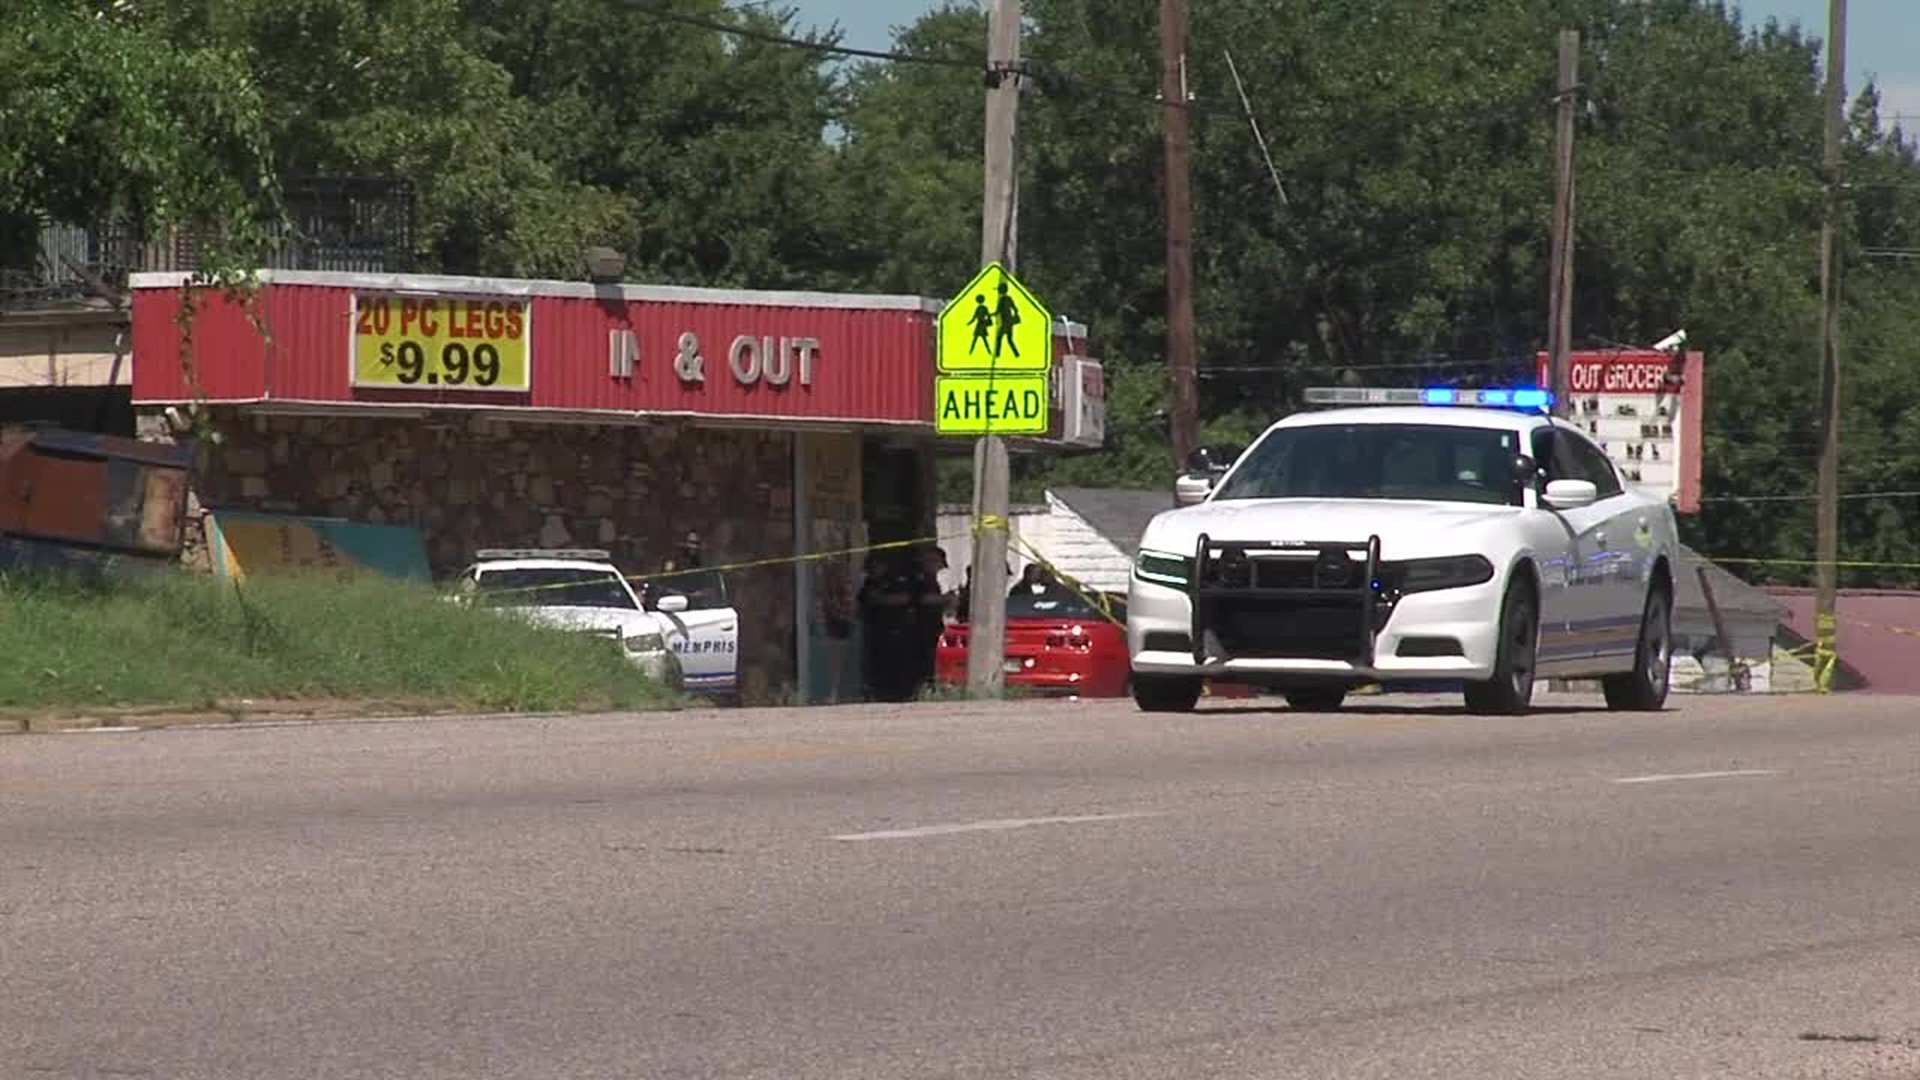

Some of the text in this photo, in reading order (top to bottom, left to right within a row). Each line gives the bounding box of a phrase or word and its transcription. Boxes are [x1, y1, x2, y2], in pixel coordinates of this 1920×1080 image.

[358, 297, 523, 340] 20 PC LEGS
[380, 340, 500, 386] $9.99
[674, 331, 705, 382] &
[728, 334, 820, 385] OUT
[1572, 363, 1602, 390] OUT
[943, 390, 1040, 419] AHEAD
[673, 640, 735, 654] MEMPHIS
